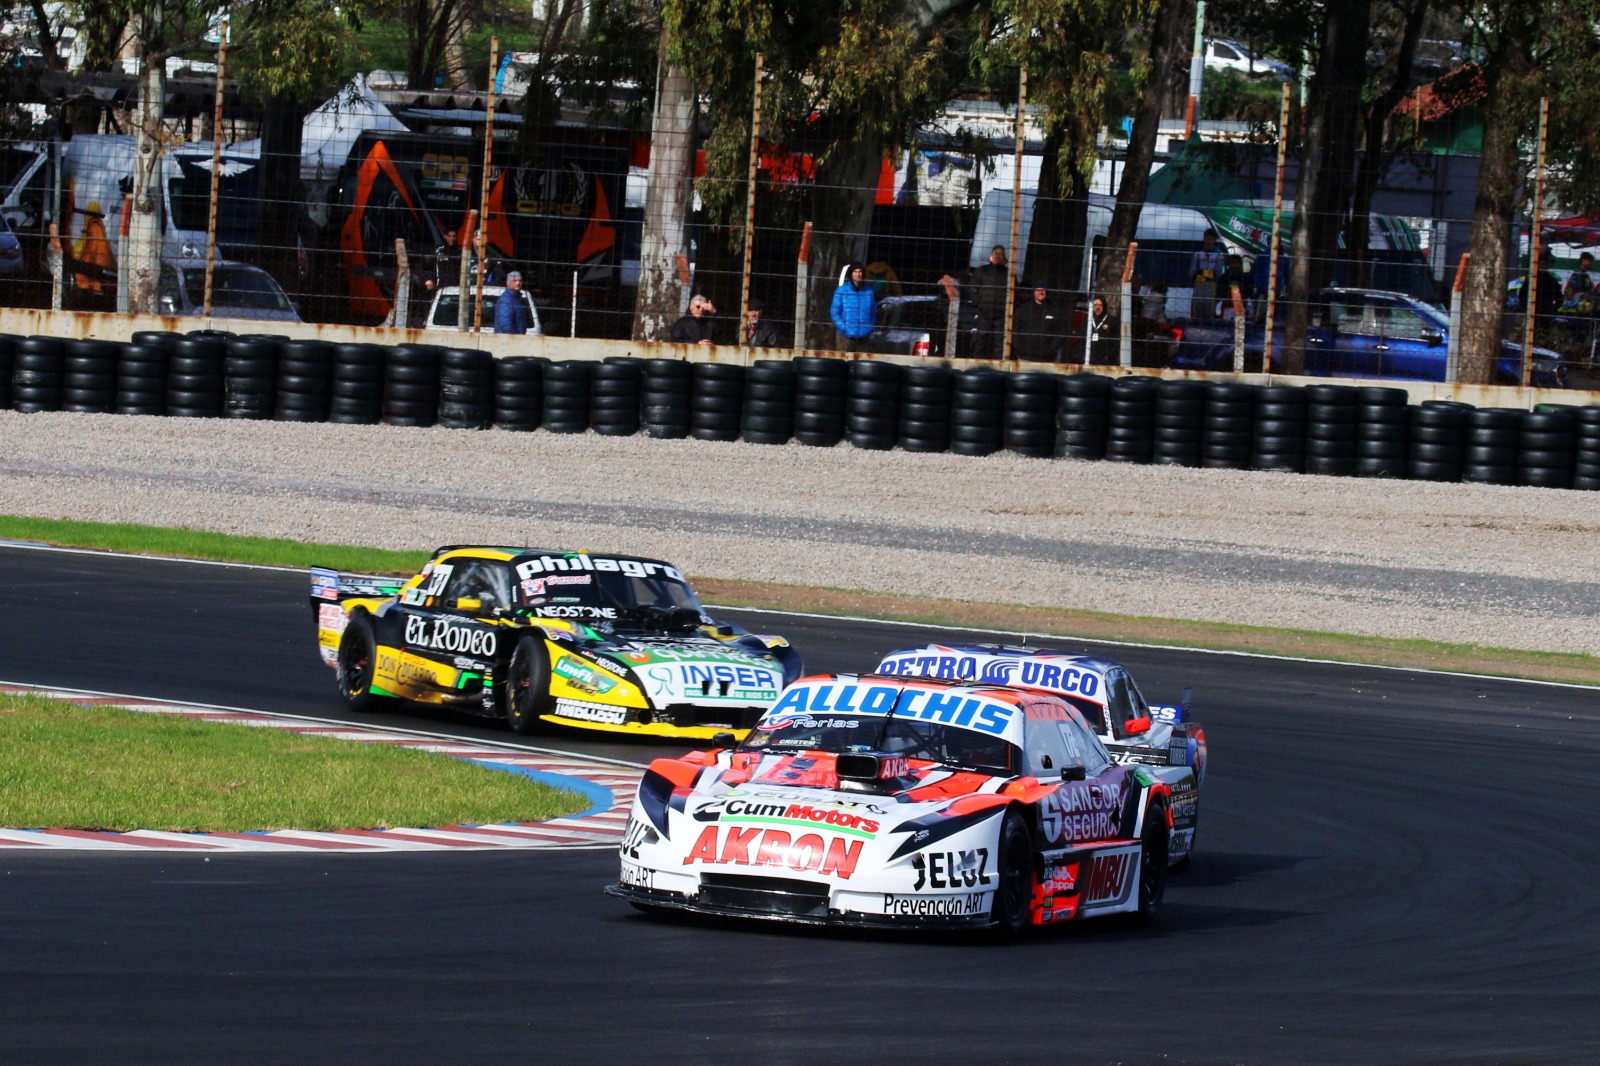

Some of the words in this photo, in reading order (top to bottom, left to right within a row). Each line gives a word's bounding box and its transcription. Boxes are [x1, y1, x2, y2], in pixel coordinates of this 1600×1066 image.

[1229, 215, 1253, 237] Henry
[516, 554, 686, 583] philagro
[535, 606, 618, 619] NEOSTONE
[596, 656, 628, 677] NEOSTONE
[681, 665, 775, 688] INSER
[879, 656, 977, 681] PETRO
[1022, 661, 1099, 697] URCO
[768, 685, 1014, 736] ALLOCHIS
[792, 718, 860, 729] Ferias
[683, 825, 864, 880] AKRON
